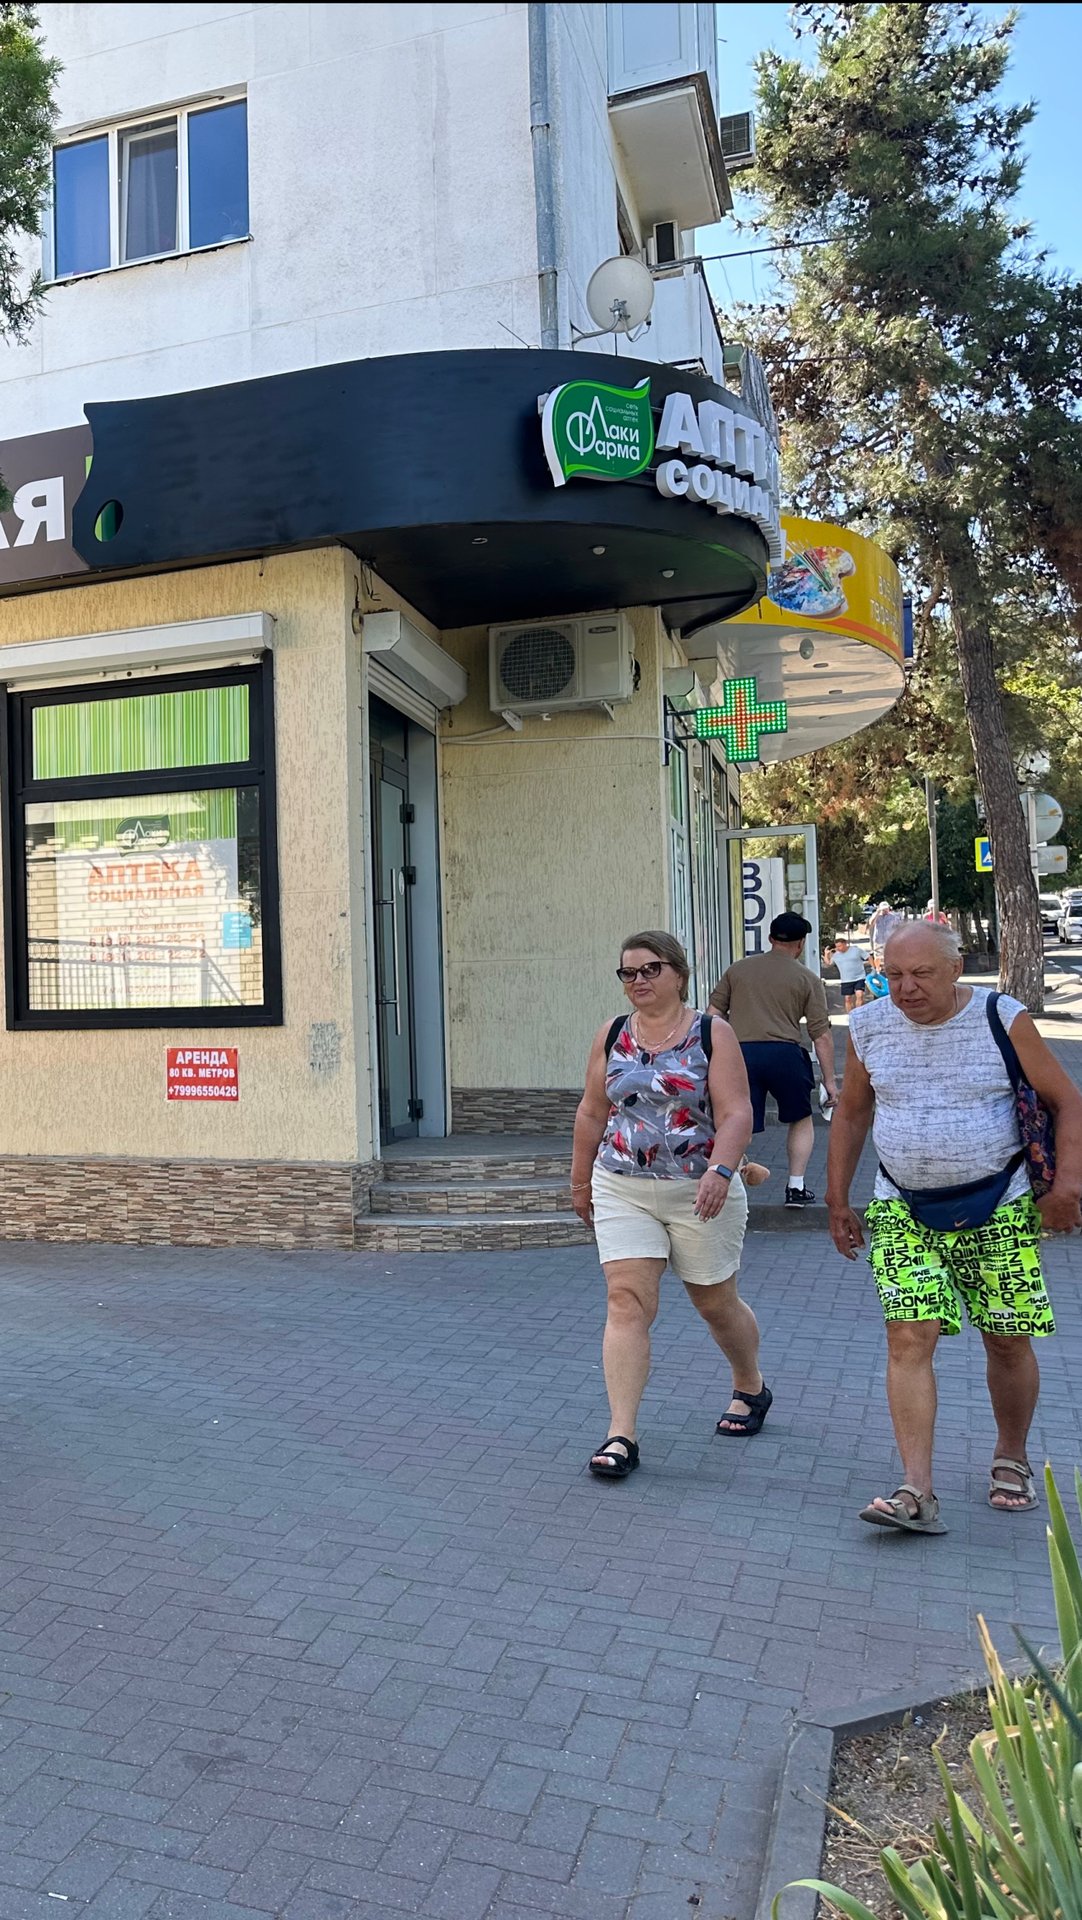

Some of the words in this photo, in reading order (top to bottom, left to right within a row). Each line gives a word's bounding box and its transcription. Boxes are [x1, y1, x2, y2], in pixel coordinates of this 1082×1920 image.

[586, 396, 639, 443] Лаки
[566, 412, 640, 460] Фарма
[655, 392, 779, 501] АПТ
[87, 859, 203, 885] АПТЕКА
[87, 885, 204, 903] СОЦИАЛЬНАЯ
[176, 1051, 228, 1067] АРЕНДА
[169, 1068, 179, 1077] 80
[182, 1068, 196, 1078] КВ.
[199, 1068, 235, 1078] МЕТРОВ
[169, 1085, 237, 1097] +79996550426
[982, 1239, 1015, 1253] FREE
[917, 1274, 943, 1284] SOME
[883, 1287, 914, 1298] OUNG
[998, 1271, 1016, 1310] ADRE
[972, 1314, 1055, 1333] AWESOME
